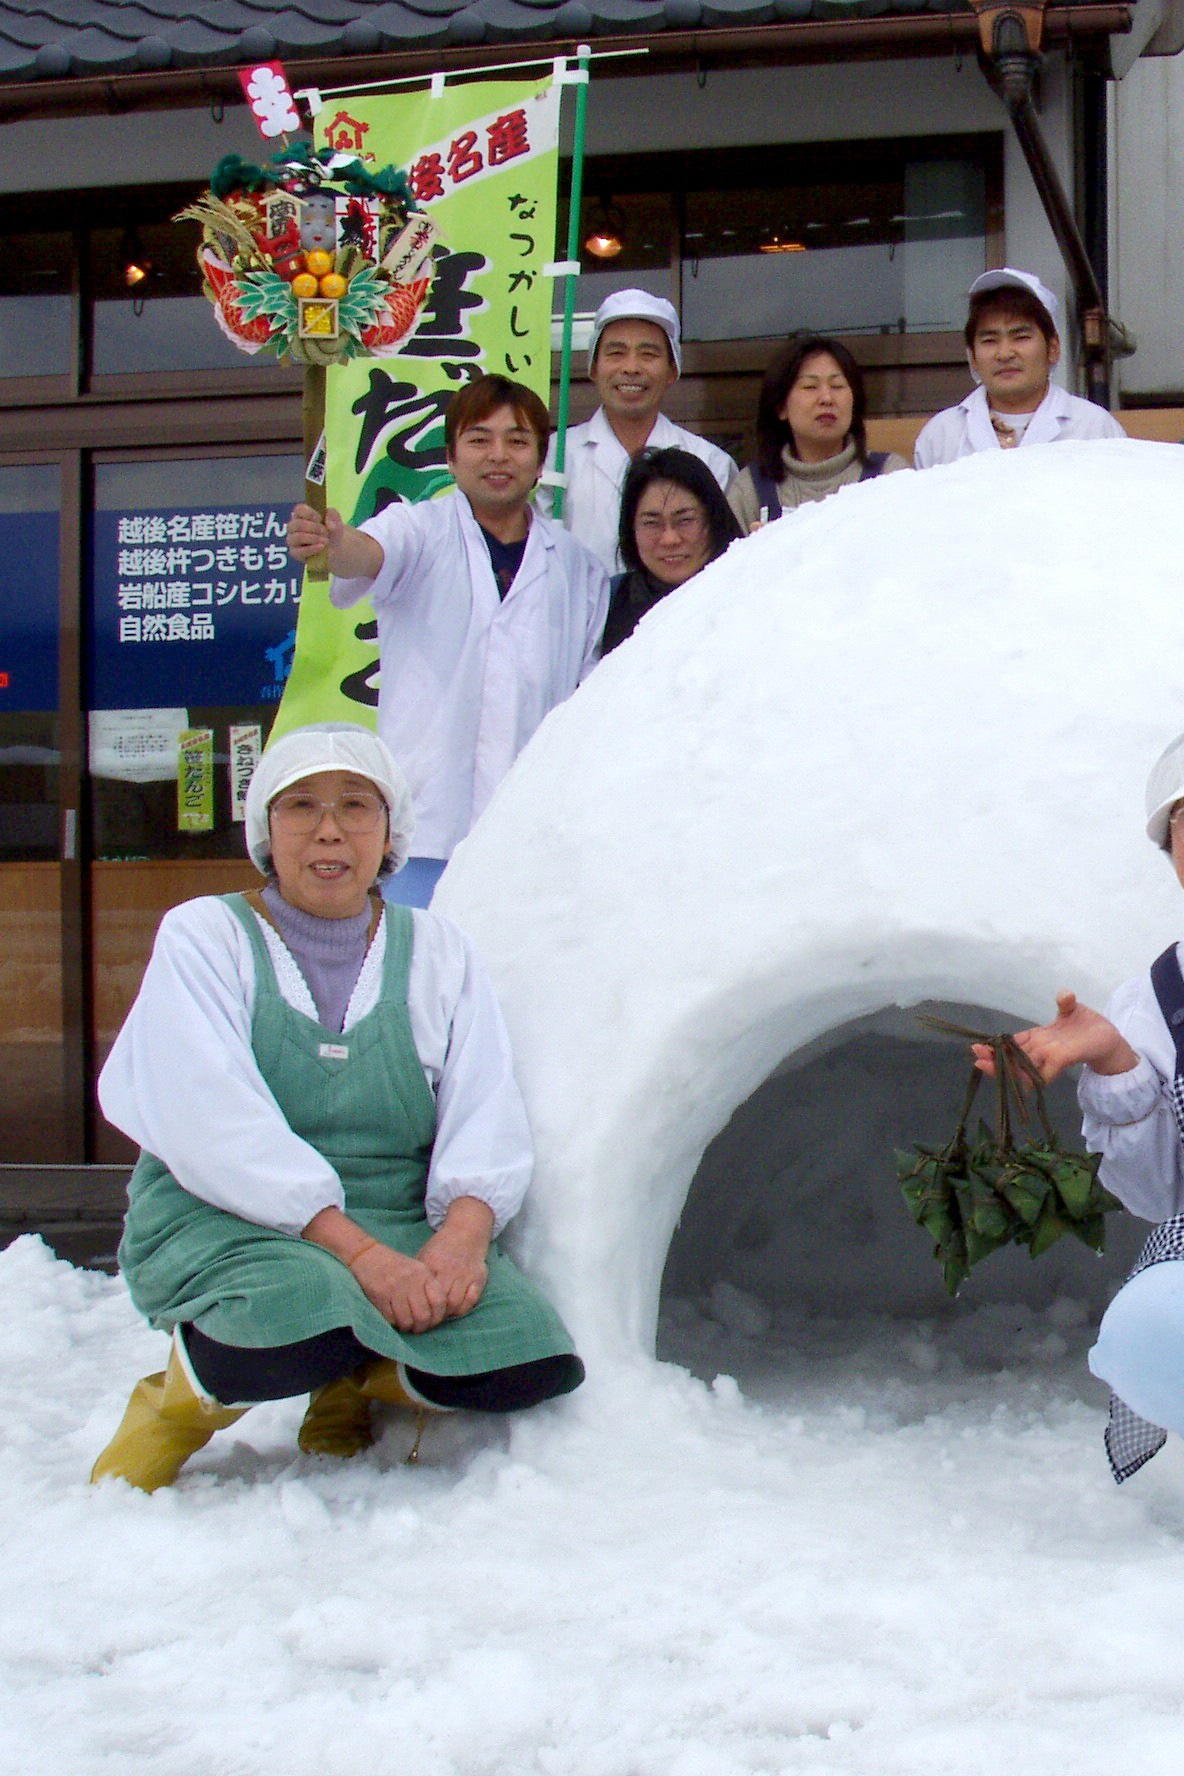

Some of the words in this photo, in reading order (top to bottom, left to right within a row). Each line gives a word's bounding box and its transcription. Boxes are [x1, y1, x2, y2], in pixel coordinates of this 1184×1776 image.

[505, 193, 539, 373] なつかしい
[118, 512, 288, 544] 越後名産笹だん
[118, 544, 288, 576] 越後杵つきもち
[118, 578, 303, 610] 岩船産コシヒカリ
[118, 613, 215, 642] 自然食品
